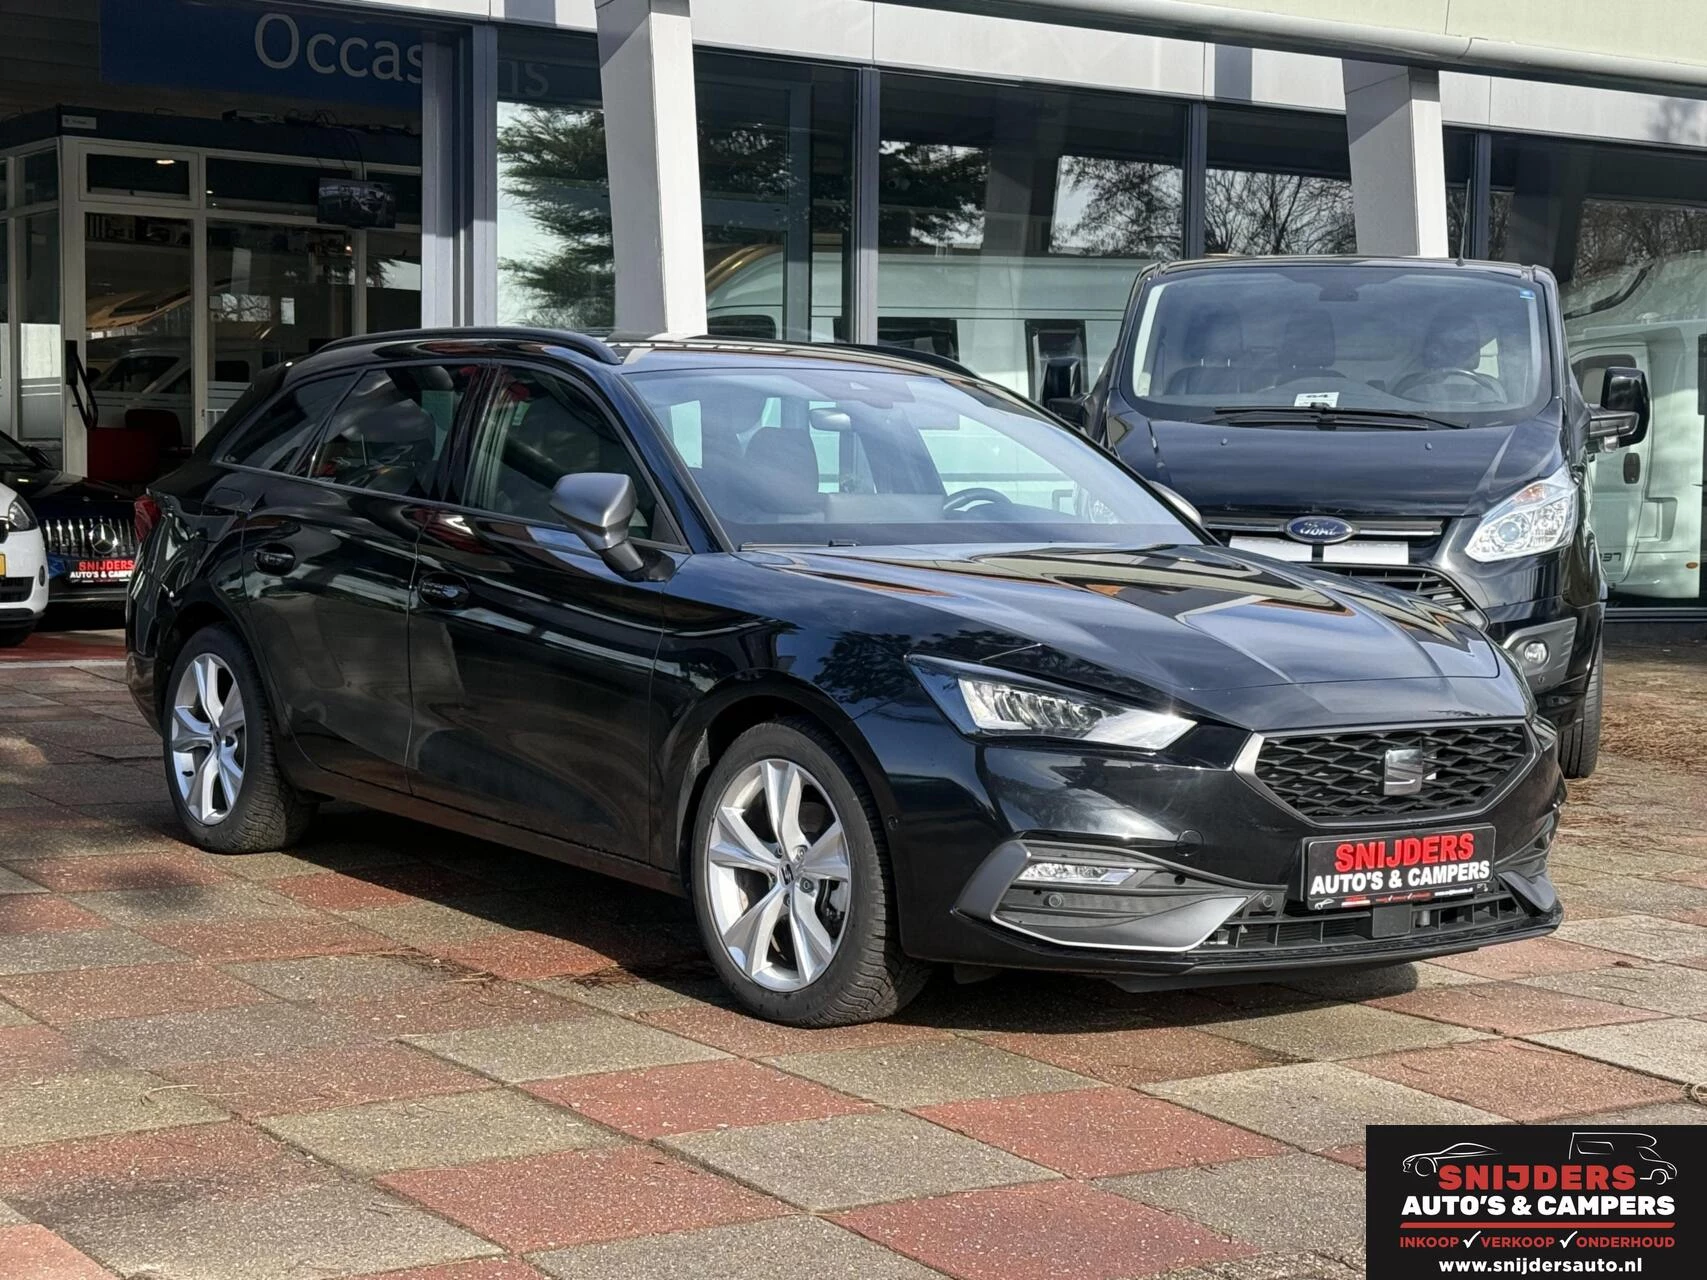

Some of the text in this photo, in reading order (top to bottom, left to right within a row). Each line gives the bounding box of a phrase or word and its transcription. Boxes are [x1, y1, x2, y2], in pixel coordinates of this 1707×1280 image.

[1599, 552, 1621, 562] 37
[78, 560, 136, 571] SNIJDERS
[69, 571, 99, 579] AUTO'S
[1335, 832, 1474, 872] SNIJDERS
[1310, 860, 1491, 895] AUTO'S & CAMPERS
